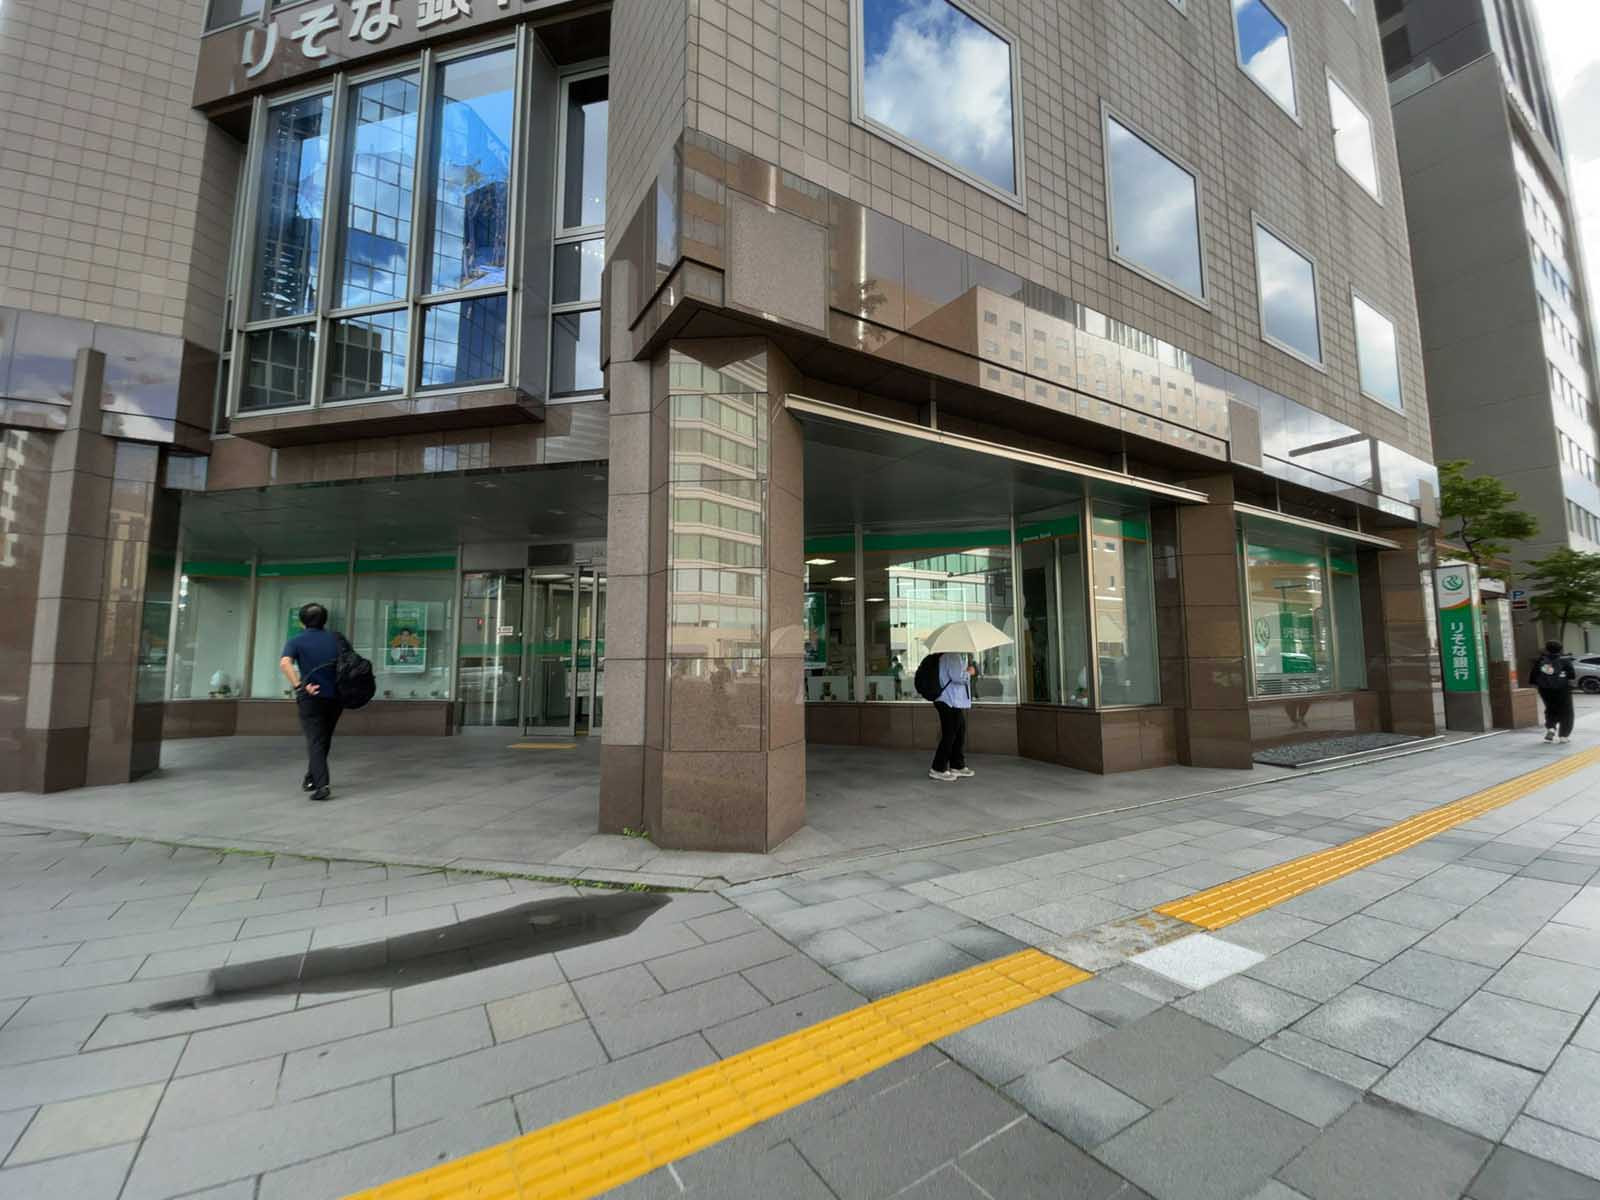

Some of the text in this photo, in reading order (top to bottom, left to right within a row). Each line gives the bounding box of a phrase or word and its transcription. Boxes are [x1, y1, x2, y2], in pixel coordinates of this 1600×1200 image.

[241, 0, 536, 77] りそな
[1451, 622, 1469, 680] りそな銀行
